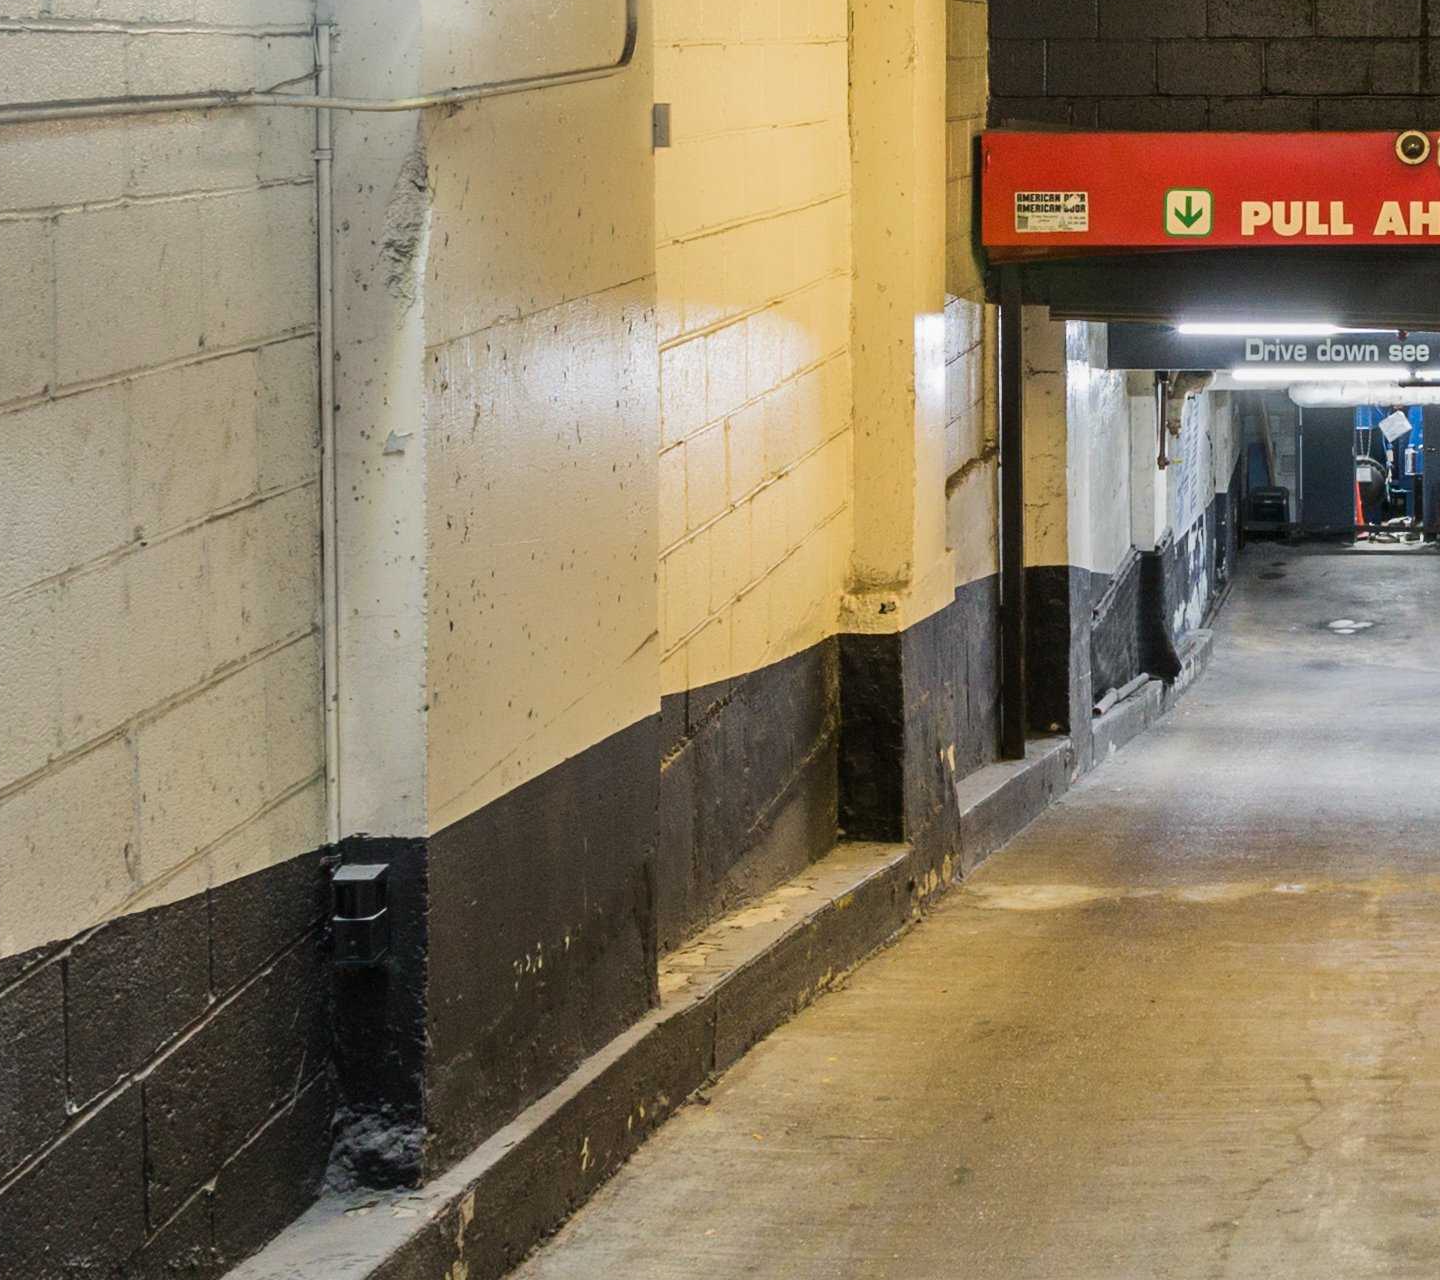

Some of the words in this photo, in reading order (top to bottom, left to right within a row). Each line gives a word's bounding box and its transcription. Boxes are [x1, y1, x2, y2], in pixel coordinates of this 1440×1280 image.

[1241, 200, 1354, 236] PULL
[1246, 339, 1307, 362] Drive
[1317, 338, 1379, 362] down
[1388, 343, 1430, 362] see
